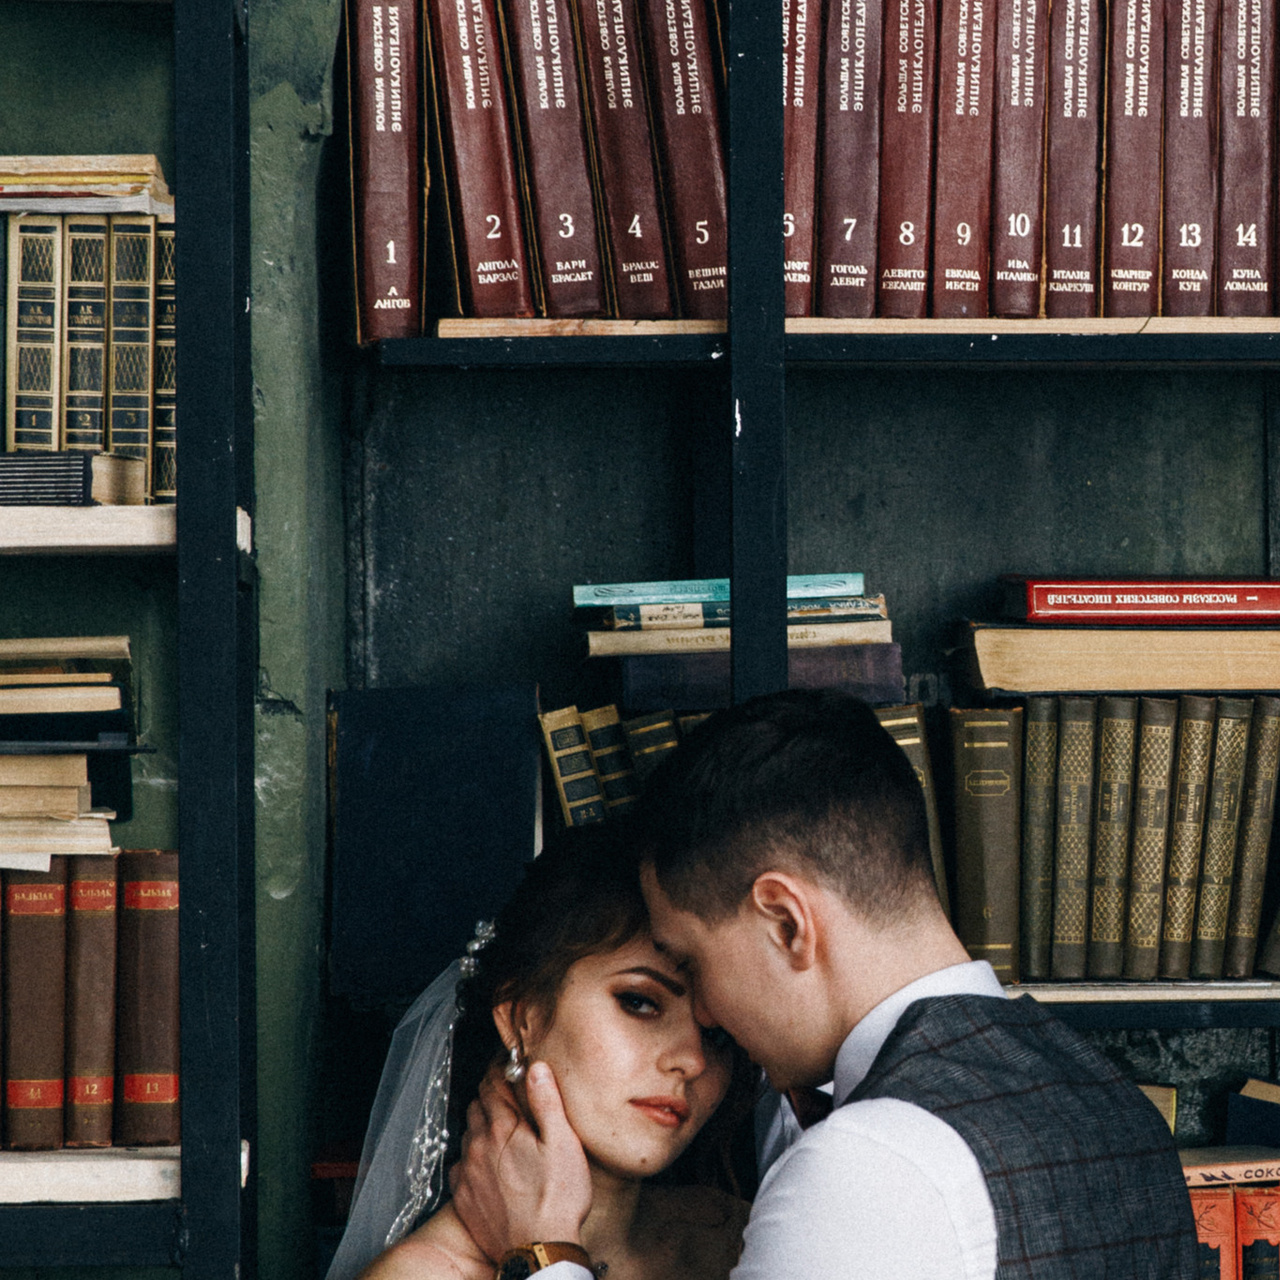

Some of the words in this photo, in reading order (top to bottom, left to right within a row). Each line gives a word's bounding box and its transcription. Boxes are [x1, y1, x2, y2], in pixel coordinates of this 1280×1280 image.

[373, 6, 383, 71] СОВЕТСКАЯ
[390, 6, 402, 133] ЭНЦИКЛОПЕДИЯ
[461, 55, 475, 109] БОЛЬШАЯ
[535, 55, 549, 109] БОЛЬШАЯ
[673, 61, 686, 115] БОЛЬШАЯ
[839, 57, 850, 112] БОЛЬШАЯ
[955, 61, 966, 115] БОЛЬШАЯ
[1064, 65, 1074, 118] БОЛЬШАЯ
[1180, 64, 1189, 117] БОЛЬШАЯ
[375, 77, 386, 132] БОЛЬШАЯ
[486, 214, 502, 239] 2
[558, 213, 575, 239] 3
[627, 214, 643, 239] 4
[695, 220, 710, 244] 5
[843, 218, 857, 242] 7
[899, 221, 916, 245] 8
[957, 222, 972, 245] 9
[1007, 213, 1030, 238] 10
[1061, 224, 1083, 247] 11
[1120, 223, 1145, 247] 12
[1179, 223, 1202, 247] 13
[1235, 223, 1258, 247] 14
[386, 240, 397, 264] 1
[477, 259, 519, 271] АНГОЛА
[555, 259, 587, 271] БАРИ
[830, 264, 868, 276] ГОГОЛЬ
[996, 271, 1038, 282] ИТАЛИКИ
[1172, 269, 1208, 281] КОНДА
[551, 271, 594, 284] БРАСЛЕТ
[830, 275, 866, 287] ДЕБИТ
[945, 281, 980, 292] ИБСЕН
[1112, 280, 1150, 292] КОНГУР
[1224, 281, 1268, 292] ЛОМАМИ
[373, 297, 411, 309] АНГОБ
[31, 414, 37, 426] 1
[78, 414, 91, 426] 2
[1047, 593, 1112, 606] ПИСАТЕЛЕЙ
[1115, 594, 1180, 605] СОВЕТСКИХ
[1183, 594, 1238, 604] РАССКАЗЫ
[85, 1084, 98, 1095] 12
[146, 1083, 159, 1094] 13
